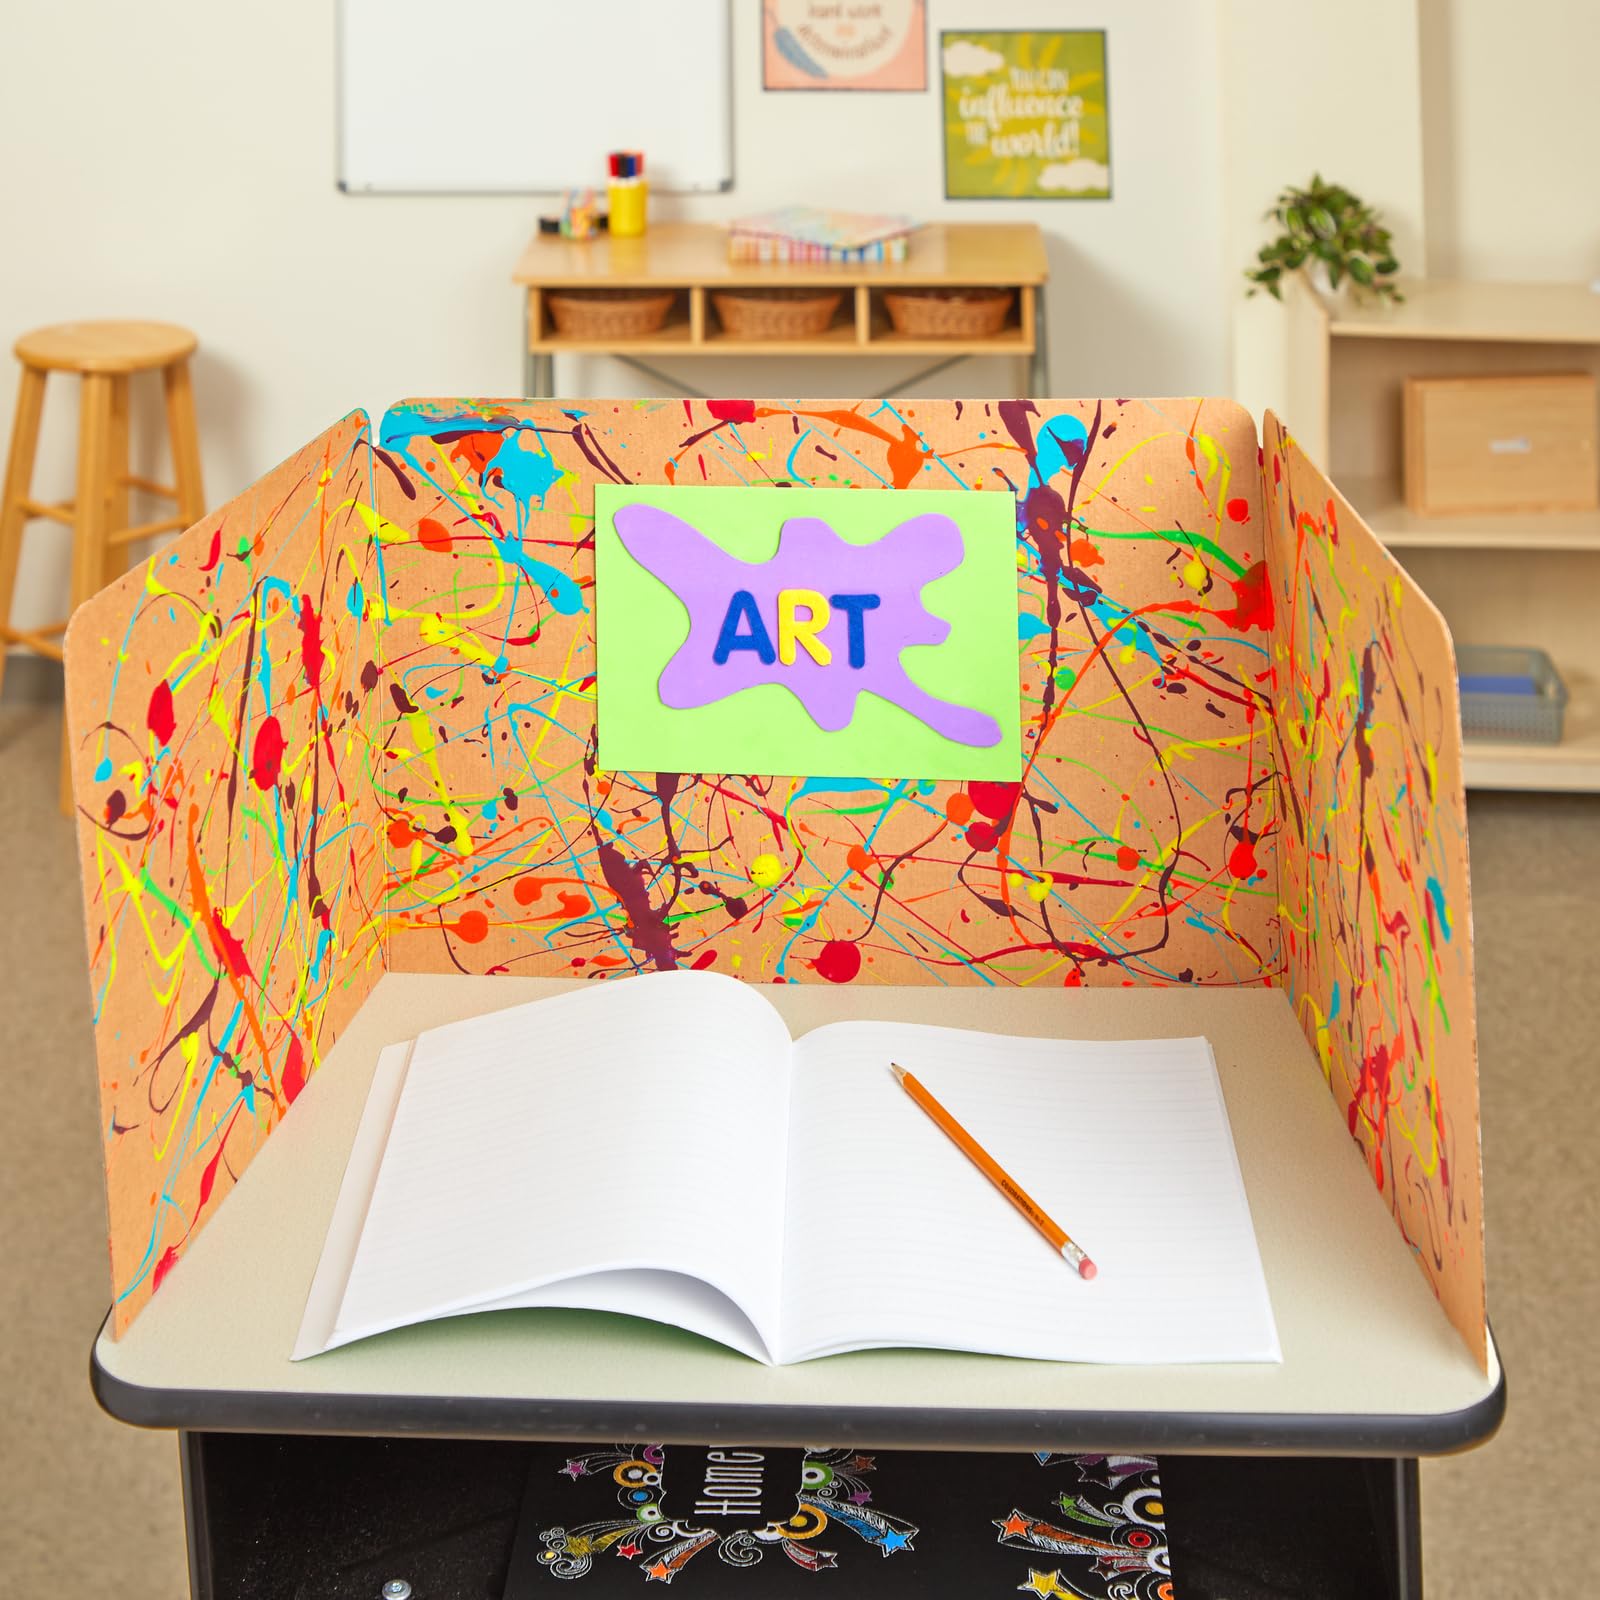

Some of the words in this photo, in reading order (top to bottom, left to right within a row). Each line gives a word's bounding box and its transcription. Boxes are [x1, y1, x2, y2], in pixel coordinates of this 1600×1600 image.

[958, 82, 1082, 132] influence
[991, 119, 1079, 158] world!
[713, 588, 881, 669] ART
[694, 1445, 764, 1515] Home
